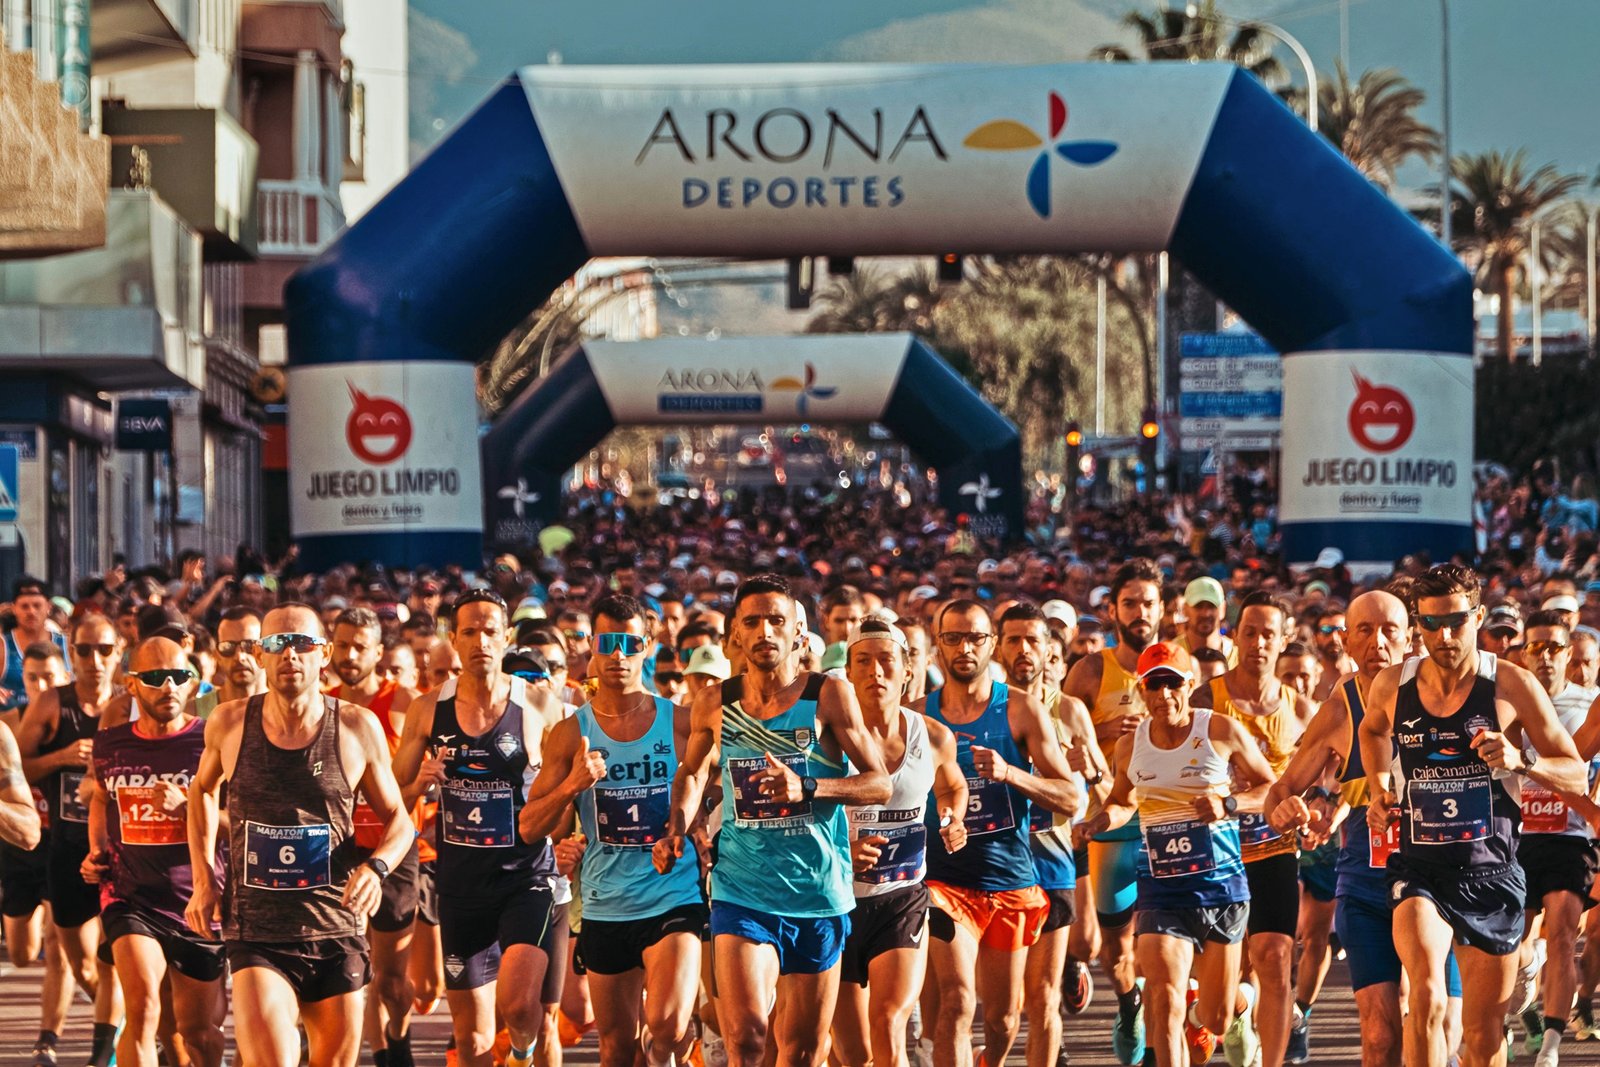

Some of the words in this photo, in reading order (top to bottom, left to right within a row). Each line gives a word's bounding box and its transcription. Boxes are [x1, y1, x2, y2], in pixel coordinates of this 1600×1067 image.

[634, 106, 949, 171] ARONA
[682, 176, 906, 209] DEPORTES
[656, 366, 766, 393] ARONA
[1302, 456, 1377, 487] JUEGO
[1380, 457, 1458, 489] LIMPIO
[306, 469, 379, 500] JUEGO
[380, 467, 461, 497] LIMPIO
[1412, 761, 1488, 780] CajaCanarias
[104, 769, 196, 792] MARATÓ
[1468, 781, 1488, 789] 21Km
[627, 803, 640, 823] 1
[968, 794, 982, 813] 5
[1442, 798, 1459, 819] 3
[1521, 801, 1564, 816] 1048
[467, 806, 483, 825] 4
[854, 811, 877, 821] MED
[307, 828, 329, 837] 21Km
[279, 844, 296, 865] 6
[888, 842, 900, 861] 7
[1165, 836, 1192, 855] 46
